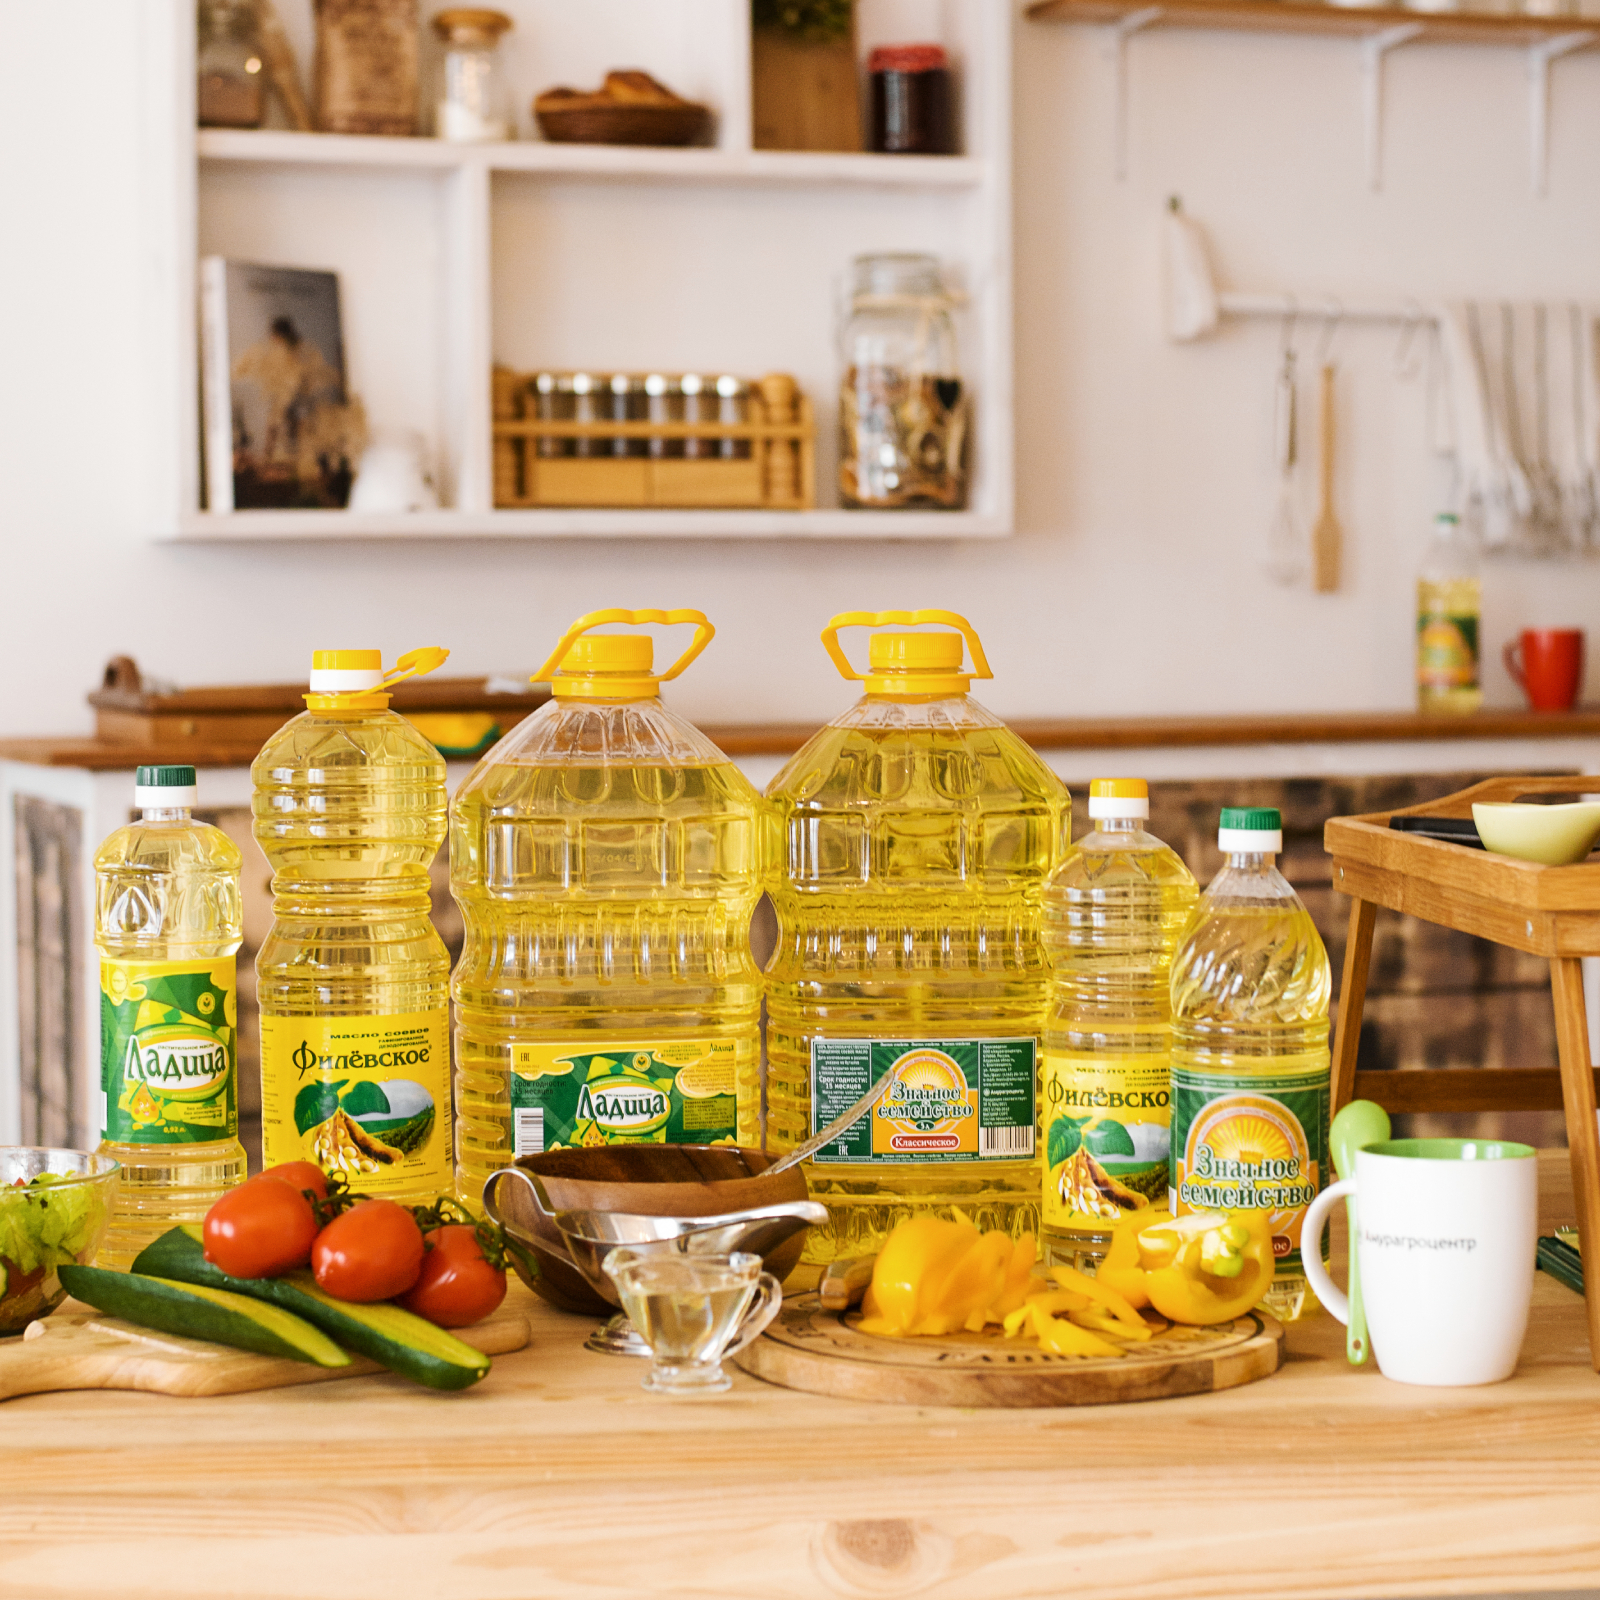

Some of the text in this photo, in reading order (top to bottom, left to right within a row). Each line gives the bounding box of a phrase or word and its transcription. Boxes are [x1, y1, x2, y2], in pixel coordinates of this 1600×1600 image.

[384, 1027, 430, 1037] соевое
[126, 1036, 227, 1082] Ладица
[292, 1039, 430, 1081] Филёвское
[514, 1080, 531, 1089] Срок
[818, 1075, 868, 1084] Срок годности:
[891, 1081, 961, 1101] Знатное
[1048, 1069, 1170, 1118] Филёвско
[579, 1085, 666, 1121] Ладица
[877, 1102, 974, 1119] семейство
[163, 1126, 178, 1134] 0,92
[895, 1137, 956, 1147] Классическое
[1194, 1143, 1300, 1180] Знатное
[1180, 1181, 1315, 1208] семейство
